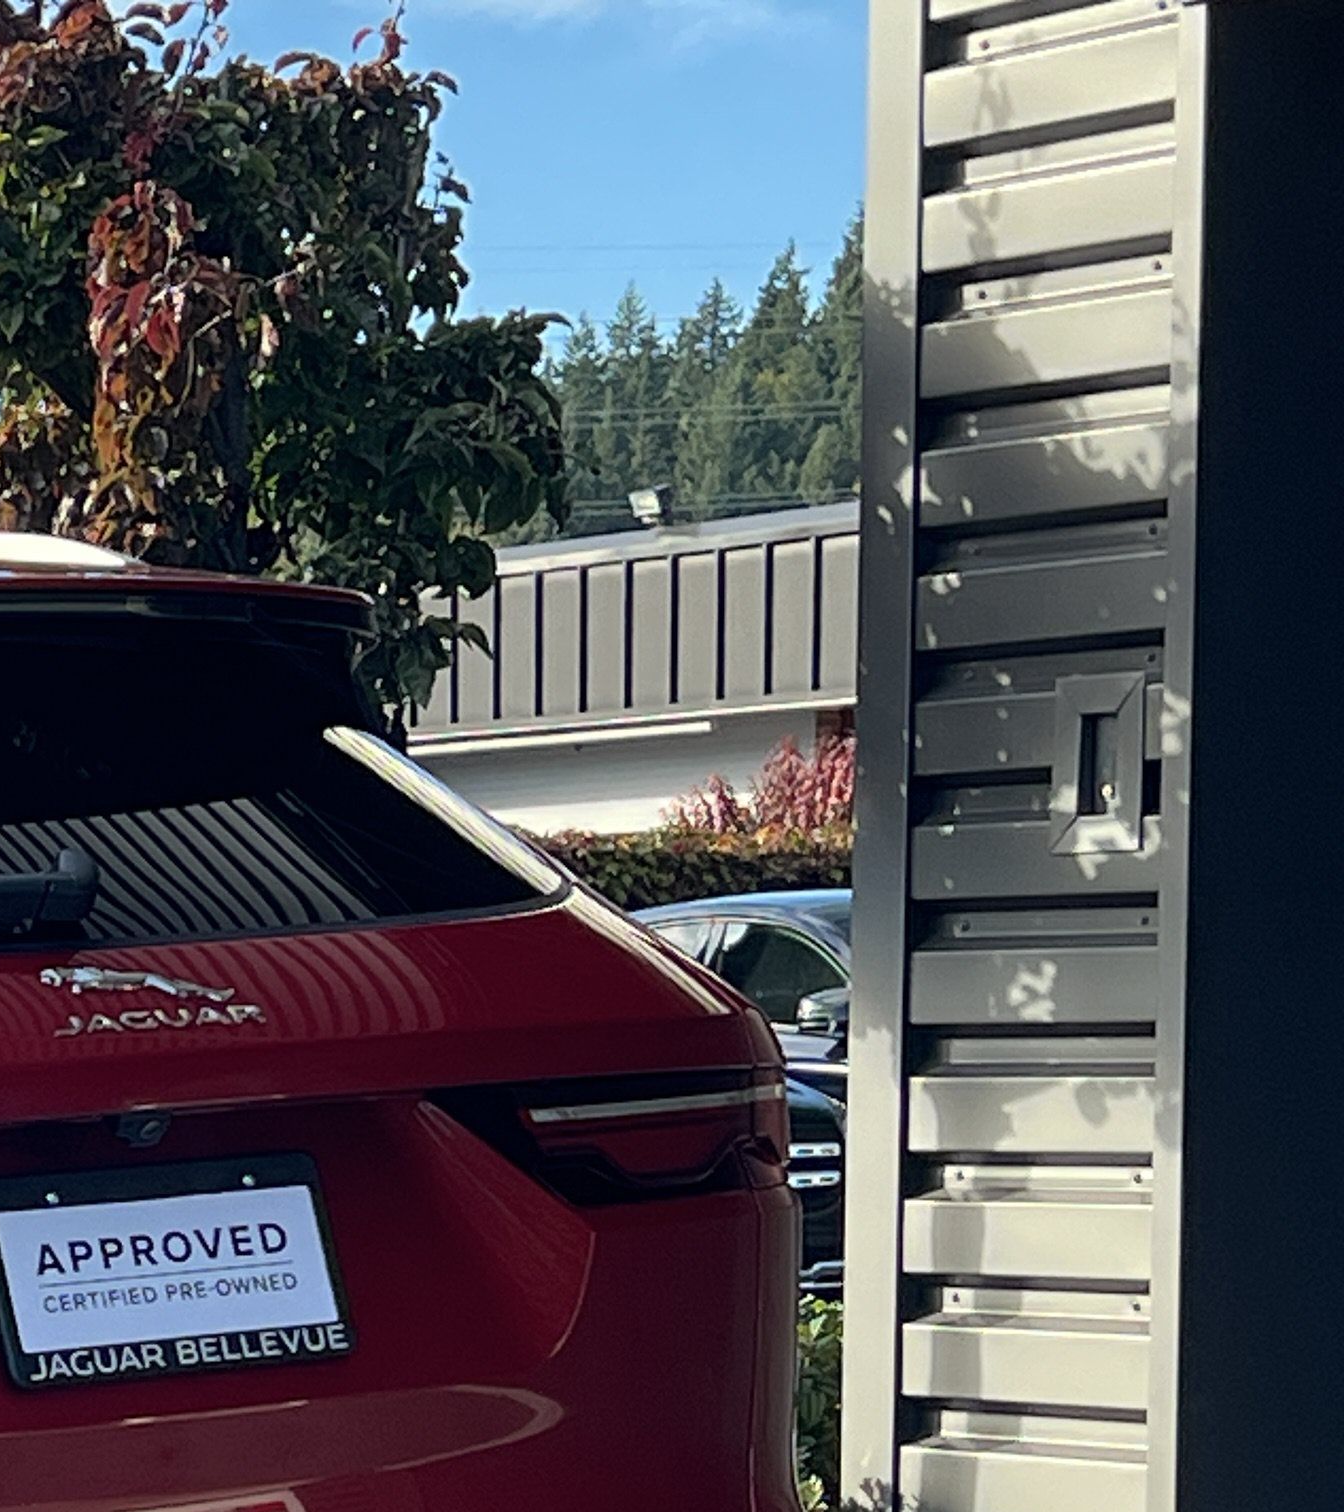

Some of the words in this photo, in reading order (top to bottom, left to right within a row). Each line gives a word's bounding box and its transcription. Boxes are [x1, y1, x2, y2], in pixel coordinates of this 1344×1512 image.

[53, 1004, 267, 1037] JAGUAR
[36, 1222, 288, 1277] APPROVED
[43, 1285, 158, 1313] CERTIFIED
[166, 1272, 298, 1302] PRE-OWNED
[30, 1343, 167, 1382] JAGUAR
[176, 1322, 349, 1366] BELLEVUE
